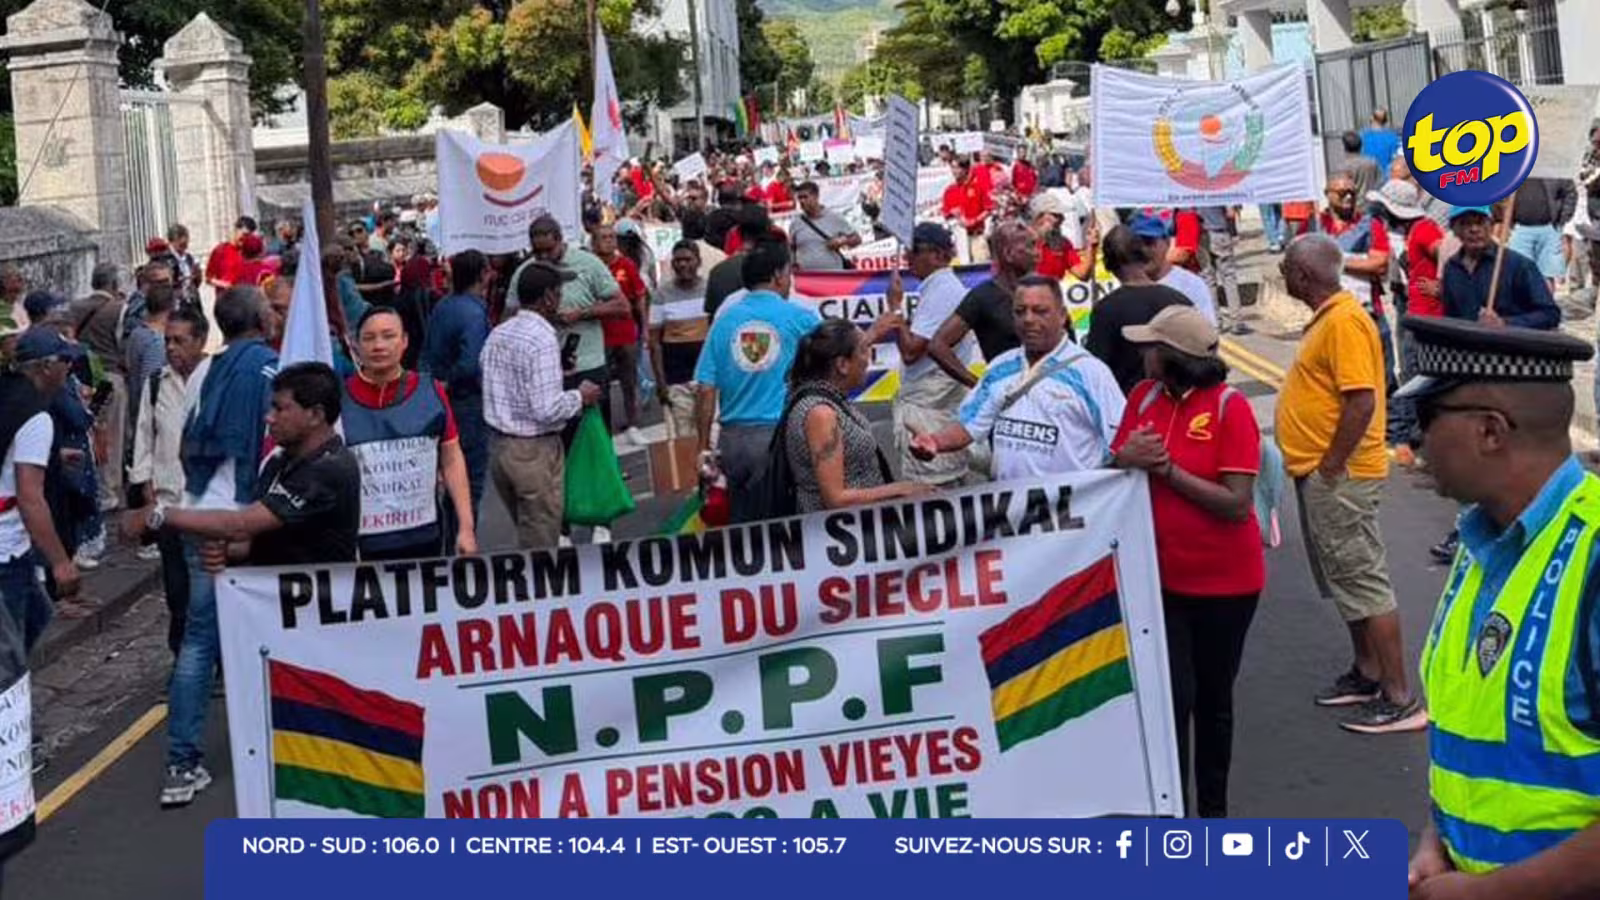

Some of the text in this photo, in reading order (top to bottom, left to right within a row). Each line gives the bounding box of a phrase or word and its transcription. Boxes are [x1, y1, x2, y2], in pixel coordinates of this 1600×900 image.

[278, 484, 1084, 629] PLATFORM KOMUN SINDIKAL
[416, 549, 1007, 679] ARNAQUE DU SIECLE
[1511, 528, 1579, 727] POLICE
[484, 633, 946, 766] N.P.P.F
[442, 727, 982, 818] NON A PENSION VIEYES
